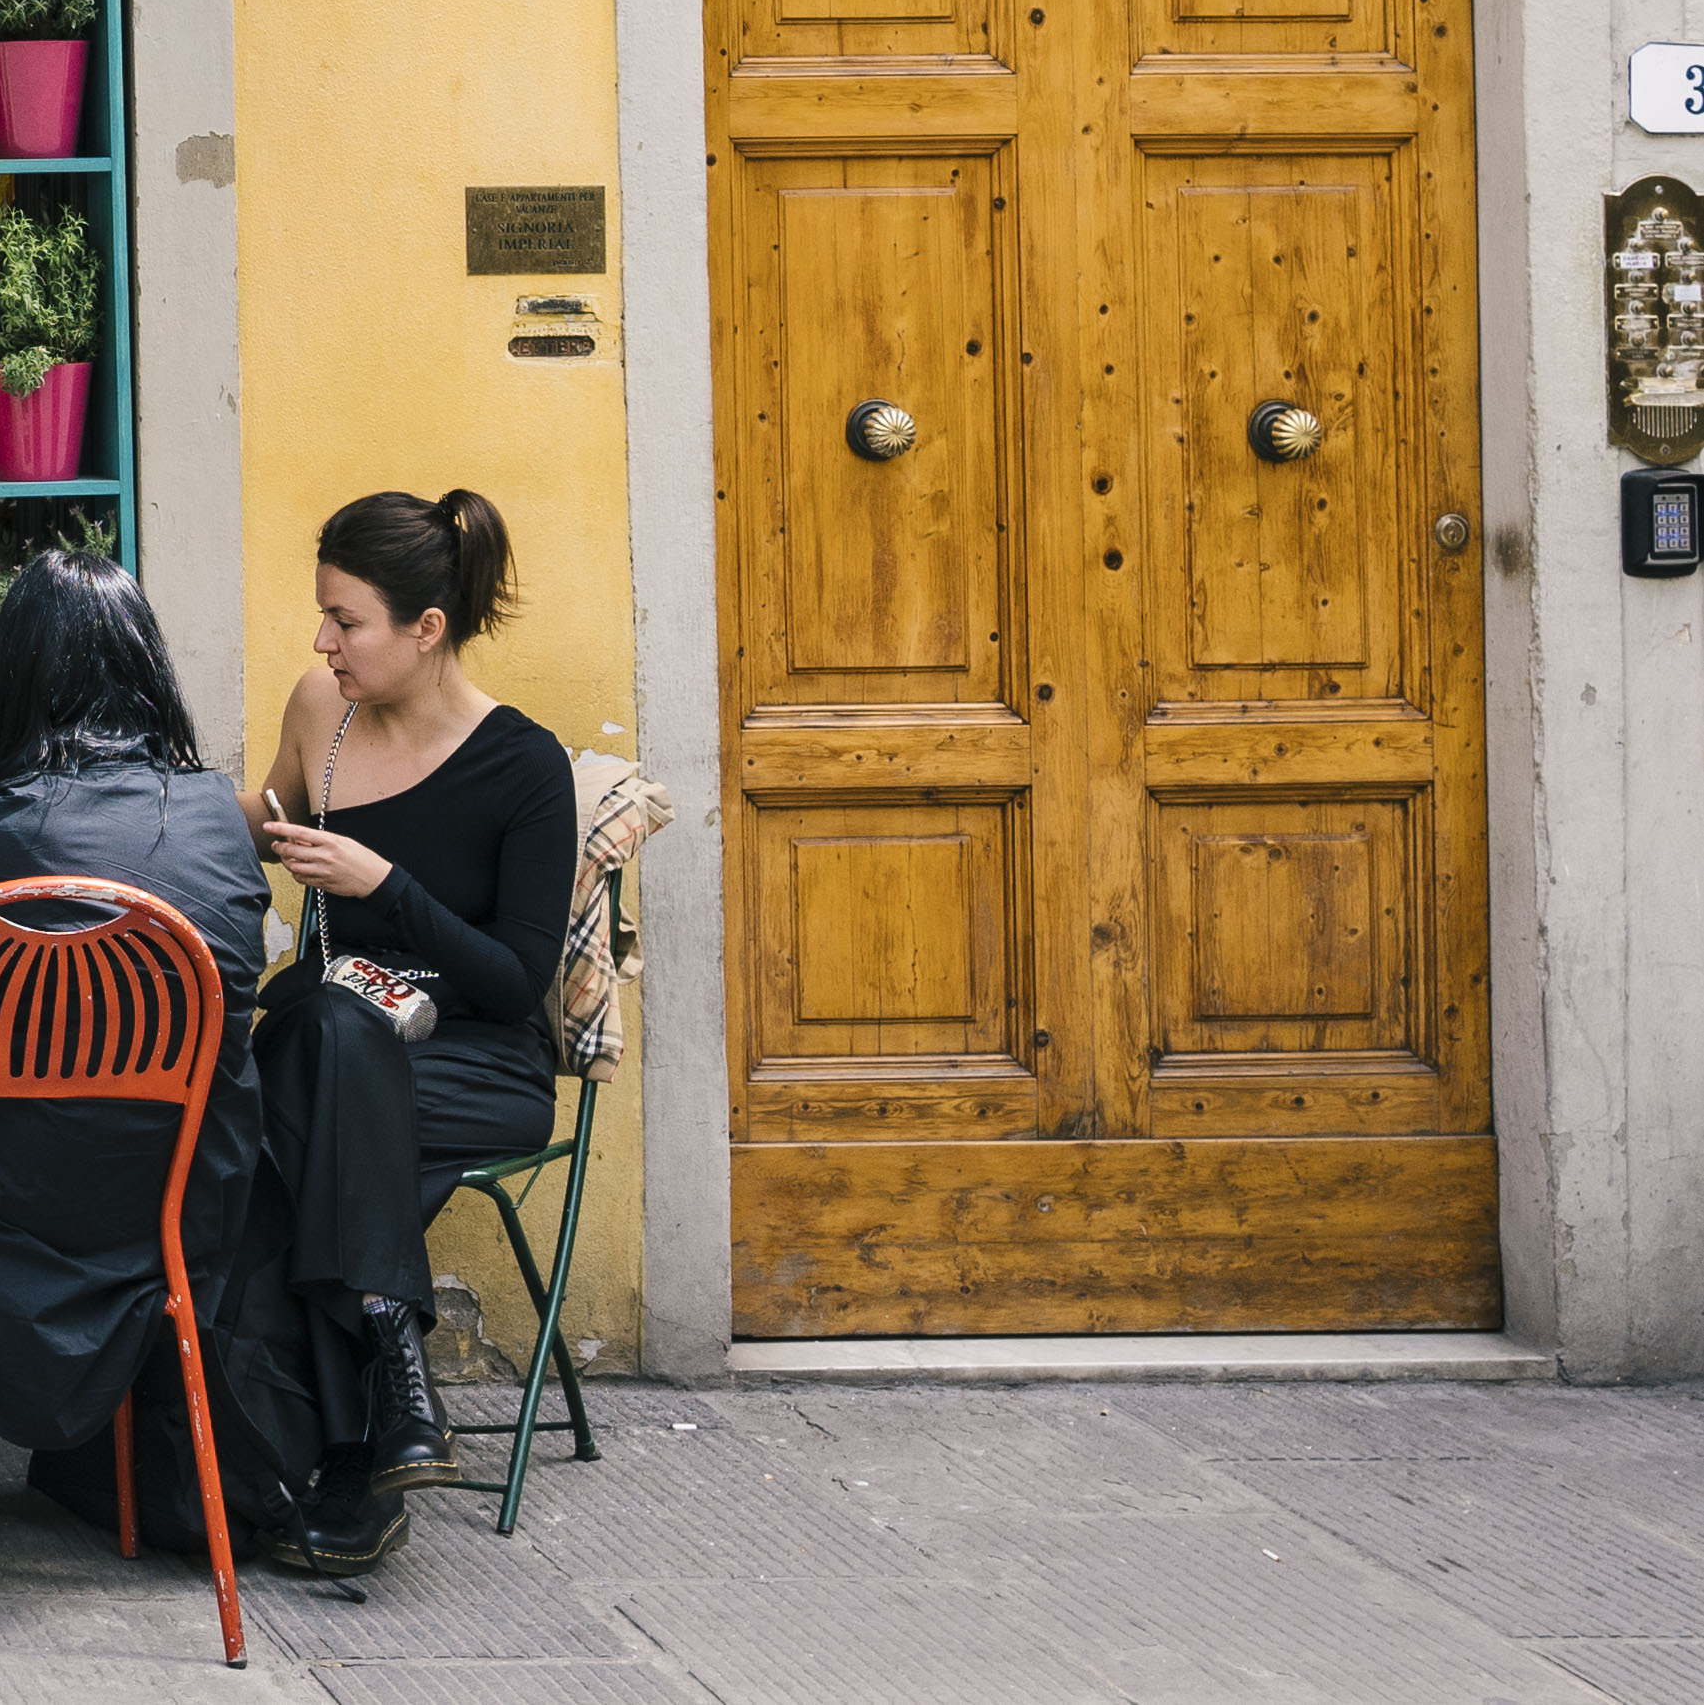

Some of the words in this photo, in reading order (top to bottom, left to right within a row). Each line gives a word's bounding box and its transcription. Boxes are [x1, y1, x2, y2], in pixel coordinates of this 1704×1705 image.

[511, 192, 575, 202] APPARTAMENTI
[579, 192, 595, 201] PER
[516, 205, 557, 214] VACANZE
[497, 222, 573, 233] SIGNORIA
